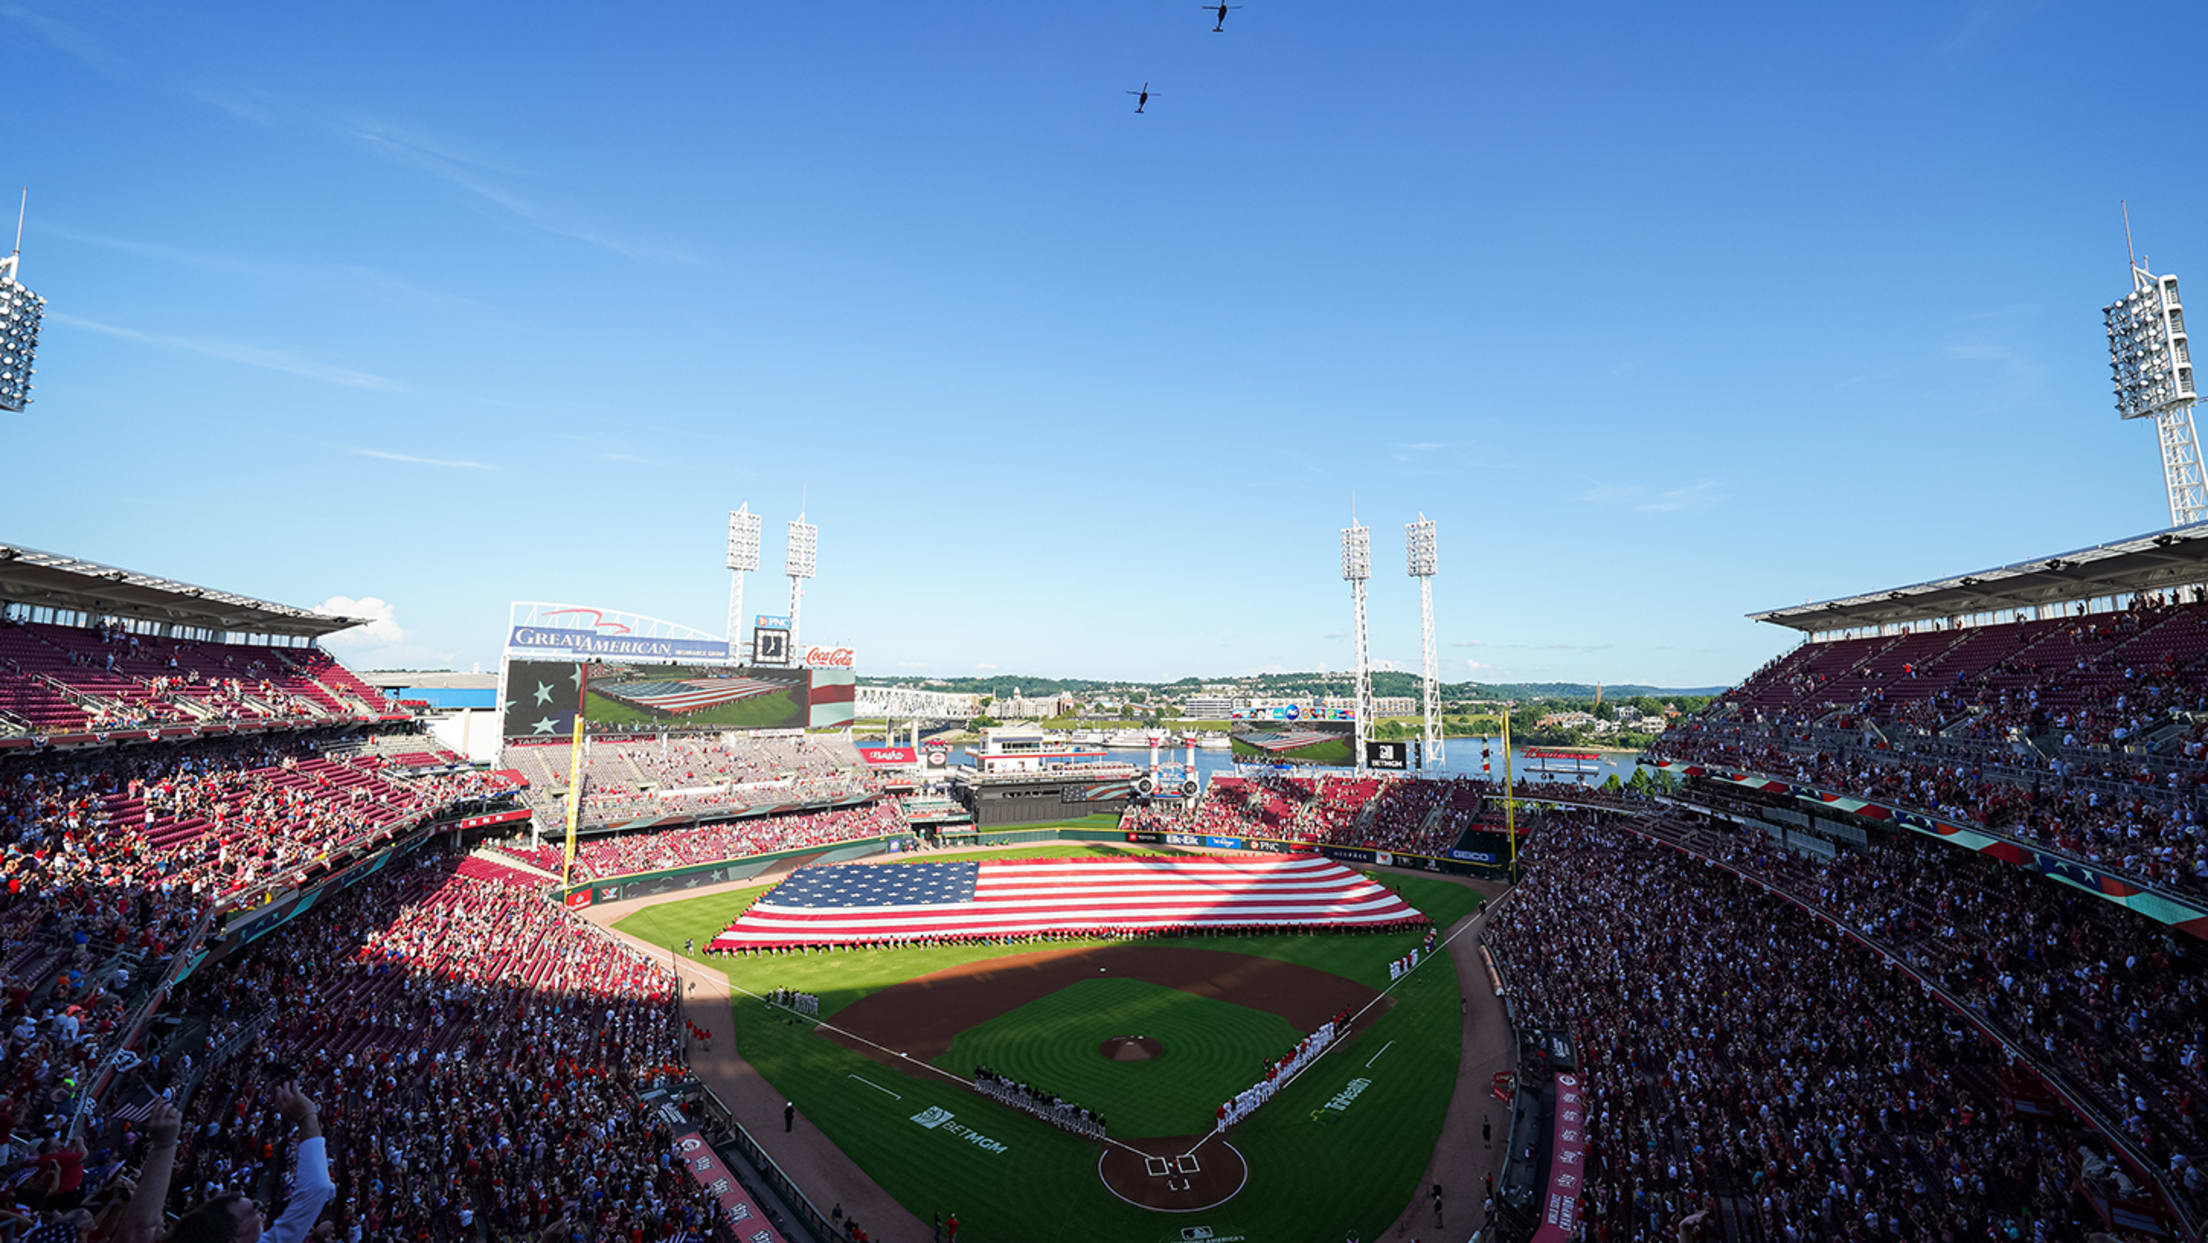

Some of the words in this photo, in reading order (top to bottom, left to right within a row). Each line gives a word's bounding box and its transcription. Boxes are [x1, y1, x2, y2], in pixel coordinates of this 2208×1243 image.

[768, 617, 788, 626] PNC
[1521, 747, 1600, 760] Budweiser
[1259, 841, 1280, 851] PNC
[1453, 850, 1489, 861] GEICO
[941, 1120, 1008, 1154] BETMGM
